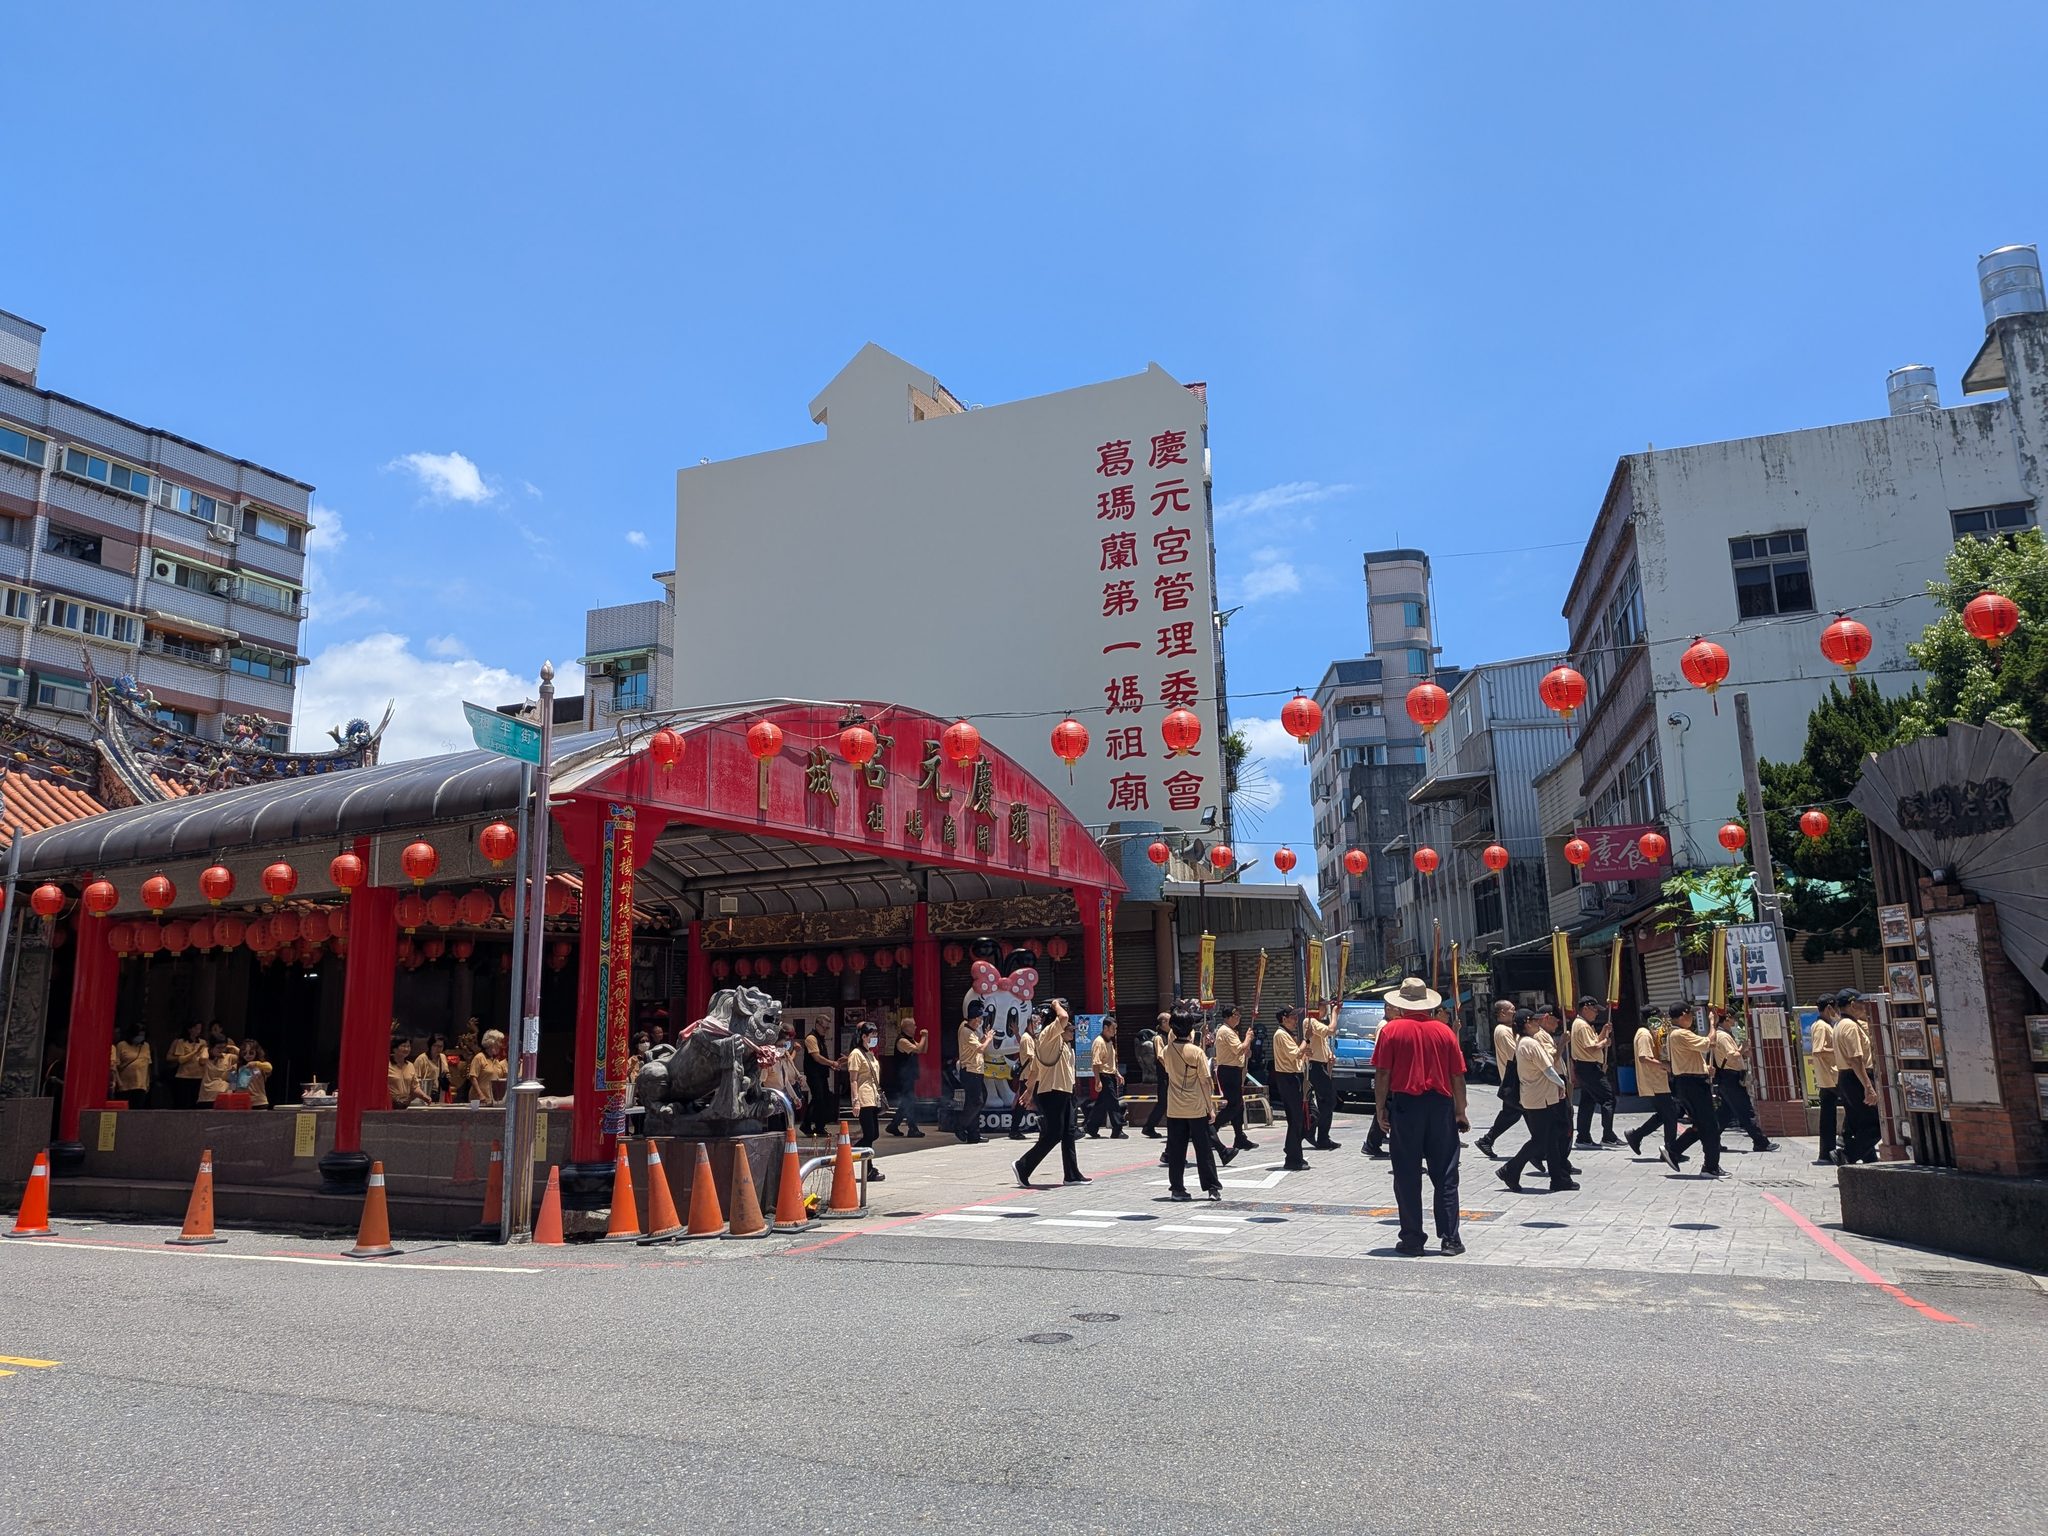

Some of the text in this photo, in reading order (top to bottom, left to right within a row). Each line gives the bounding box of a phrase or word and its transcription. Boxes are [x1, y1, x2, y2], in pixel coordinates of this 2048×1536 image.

[1096, 439, 1150, 811] 葛瑪蘭第一媽祖廟
[1148, 430, 1204, 811] 慶元宮管理委會
[1590, 835, 1649, 871] 素食
[1743, 925, 1773, 943] WC
